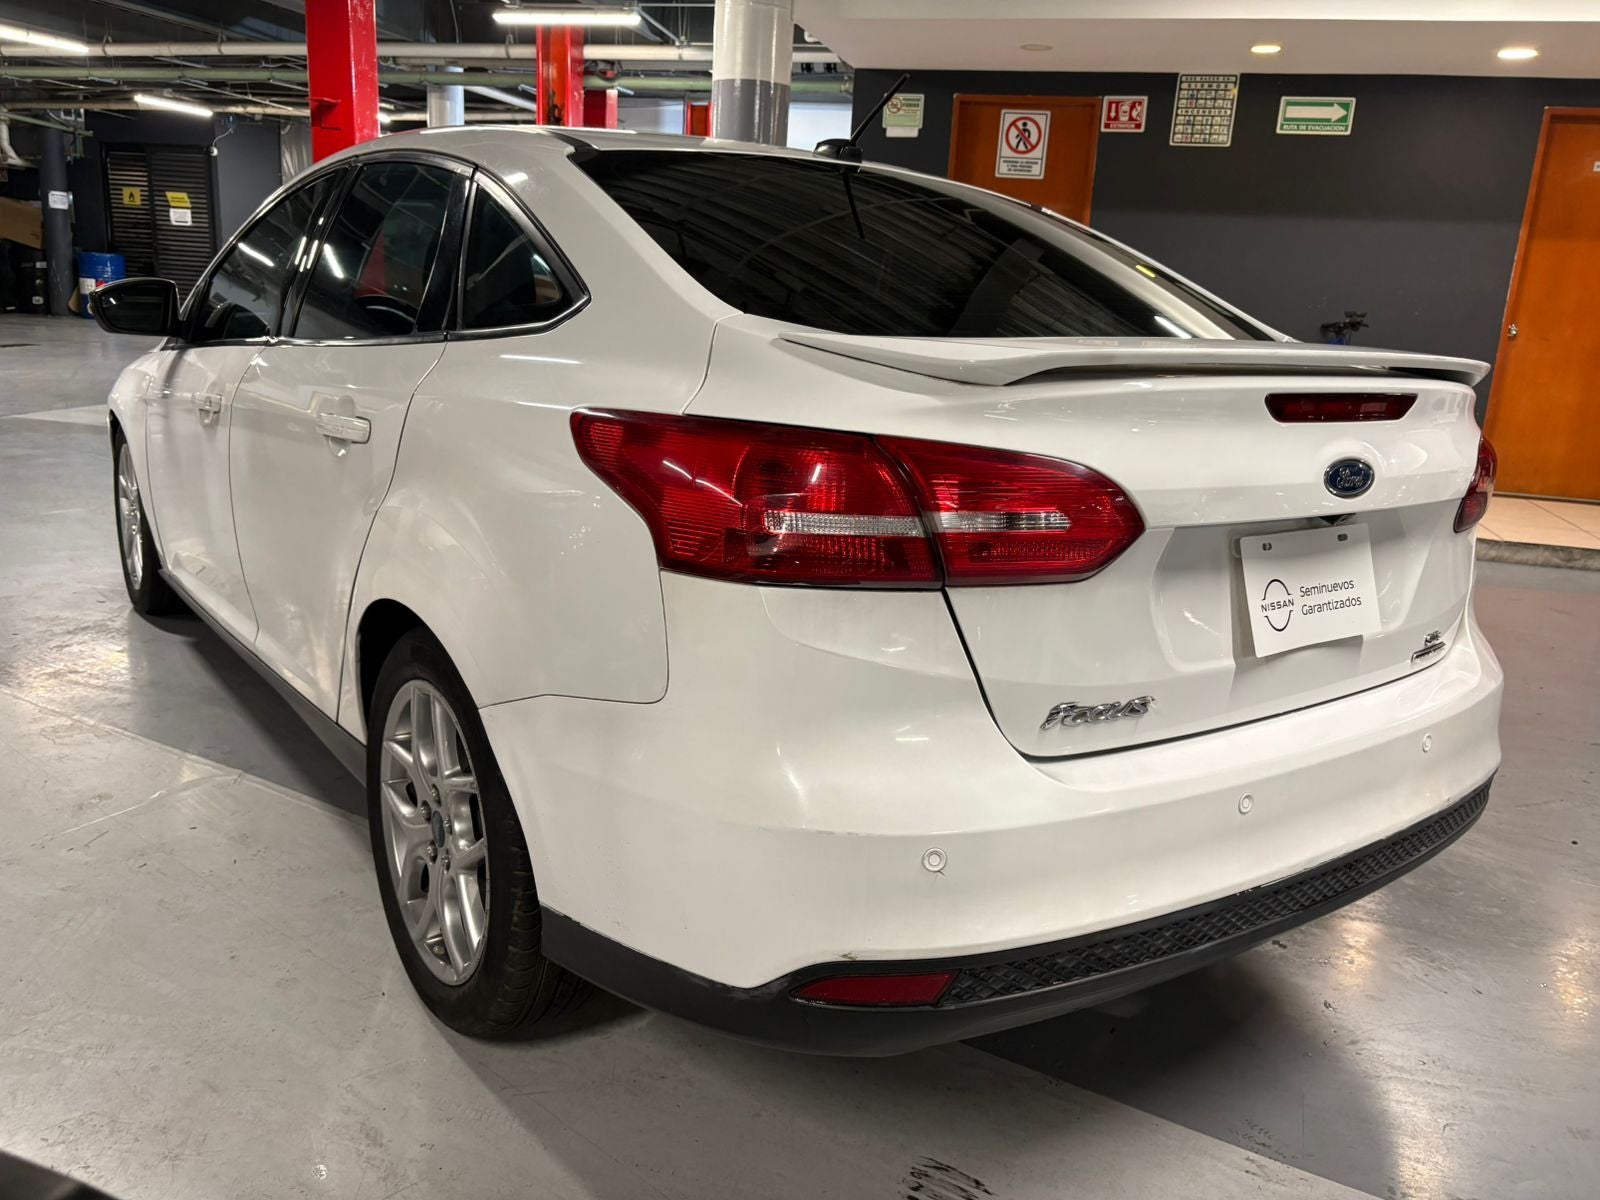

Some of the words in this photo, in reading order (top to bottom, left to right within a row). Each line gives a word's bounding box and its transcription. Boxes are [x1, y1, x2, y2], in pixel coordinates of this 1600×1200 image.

[1299, 579, 1355, 598] Seminuevos
[1261, 599, 1295, 613] NISSAN
[1301, 595, 1362, 616] Garantizados
